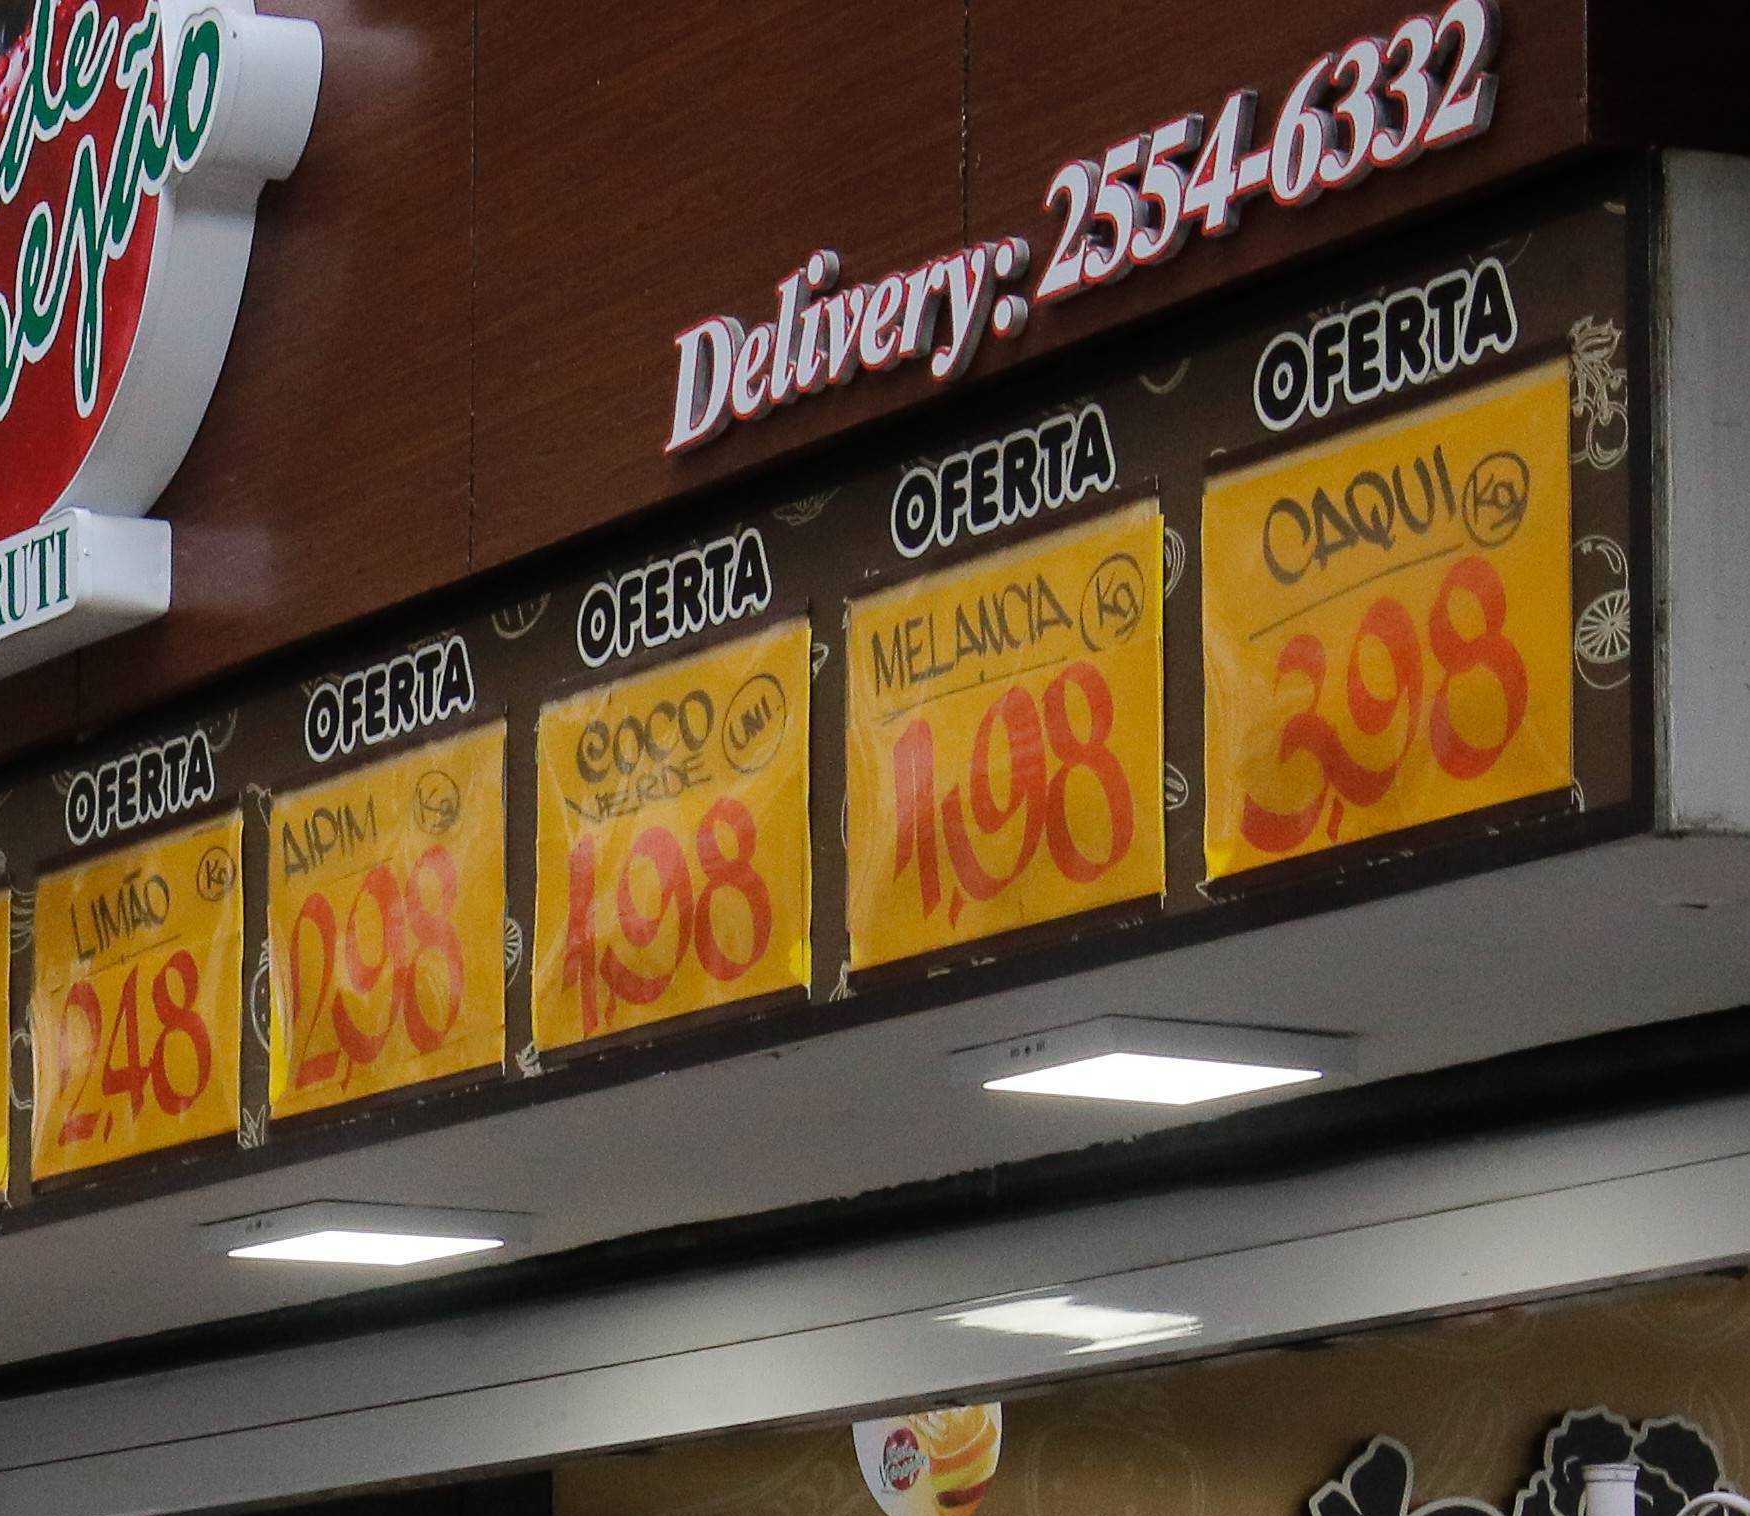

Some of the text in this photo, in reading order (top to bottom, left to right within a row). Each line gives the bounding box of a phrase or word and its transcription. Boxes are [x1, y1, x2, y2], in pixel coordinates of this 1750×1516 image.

[663, 0, 1496, 456] Delivery: 2554-6332
[1253, 254, 1519, 433] OFERTA
[890, 402, 1116, 559] OFERTA
[1261, 445, 1458, 588] CAQUI
[576, 526, 772, 669] OFERTA
[871, 572, 1074, 698] MELANCIA
[304, 635, 476, 763] OFERTA
[576, 690, 715, 786] COCO
[64, 729, 215, 848] OFERTA
[280, 795, 380, 880] AIPIM
[71, 872, 172, 962] LIMÃO
